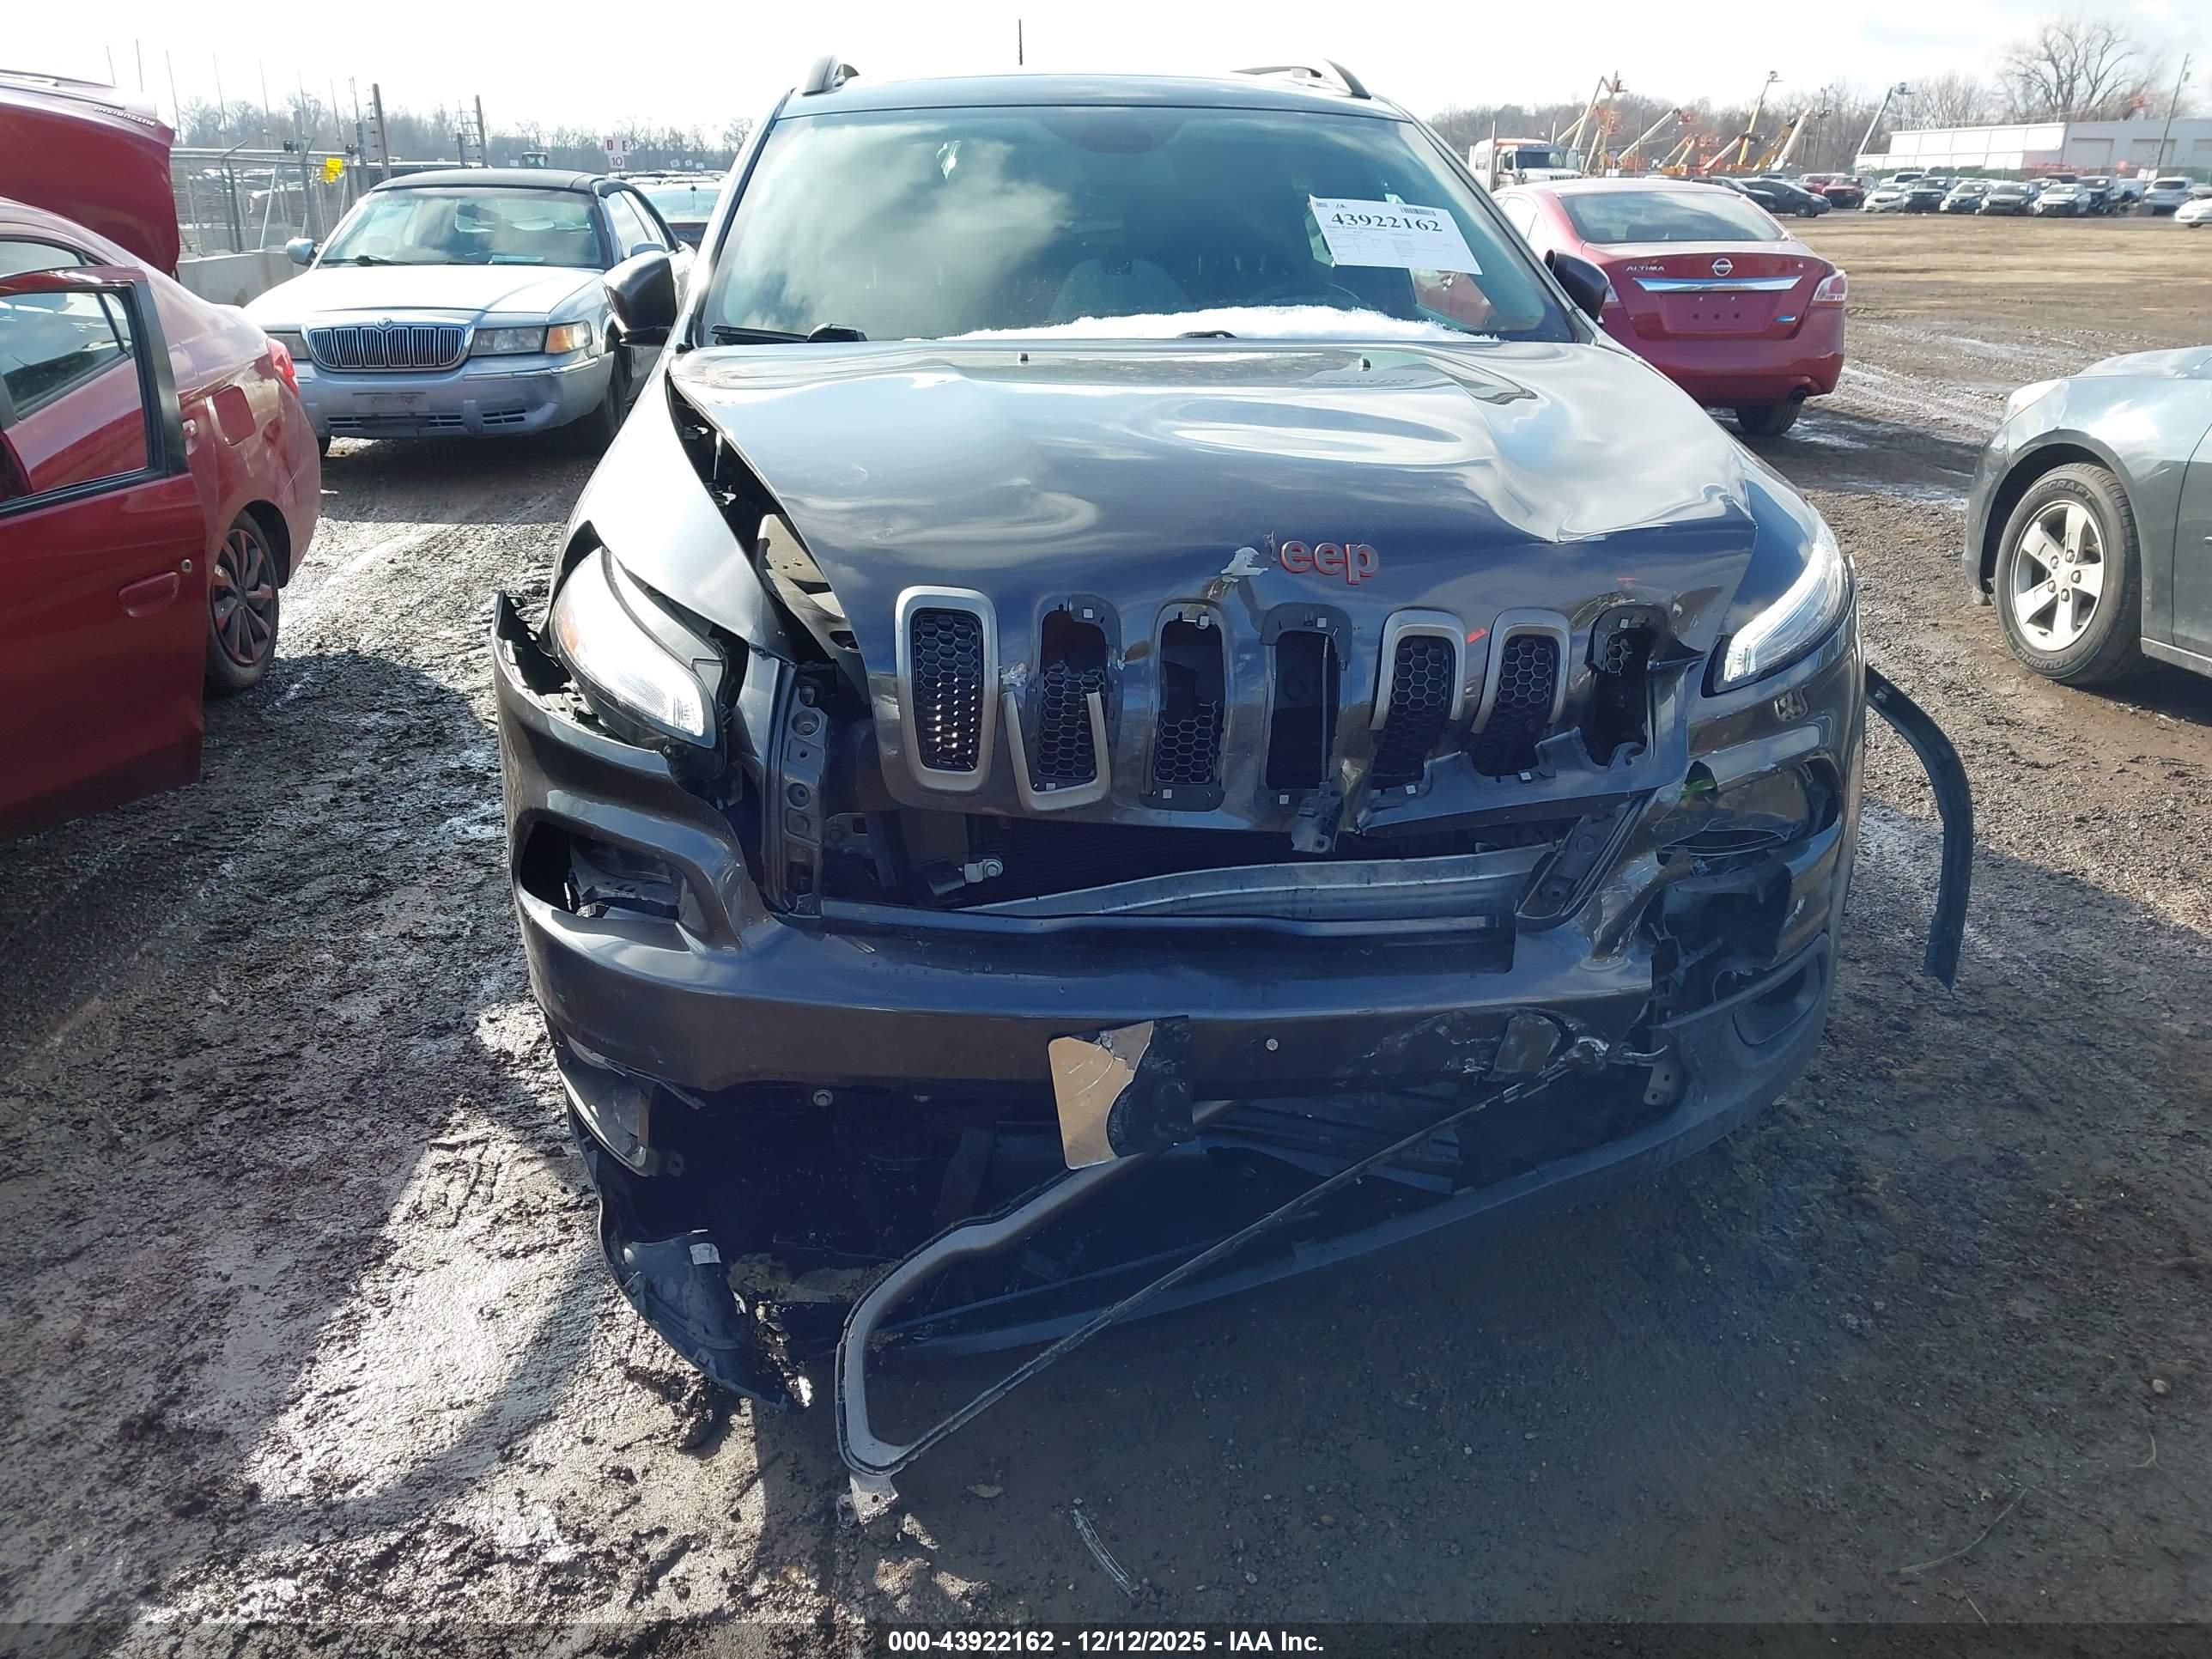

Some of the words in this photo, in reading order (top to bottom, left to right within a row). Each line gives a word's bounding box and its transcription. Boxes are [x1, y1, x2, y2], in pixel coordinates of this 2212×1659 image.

[606, 139, 613, 151] D
[622, 140, 628, 152] E
[611, 156, 623, 167] 10
[1331, 212, 1443, 233] 43922162
